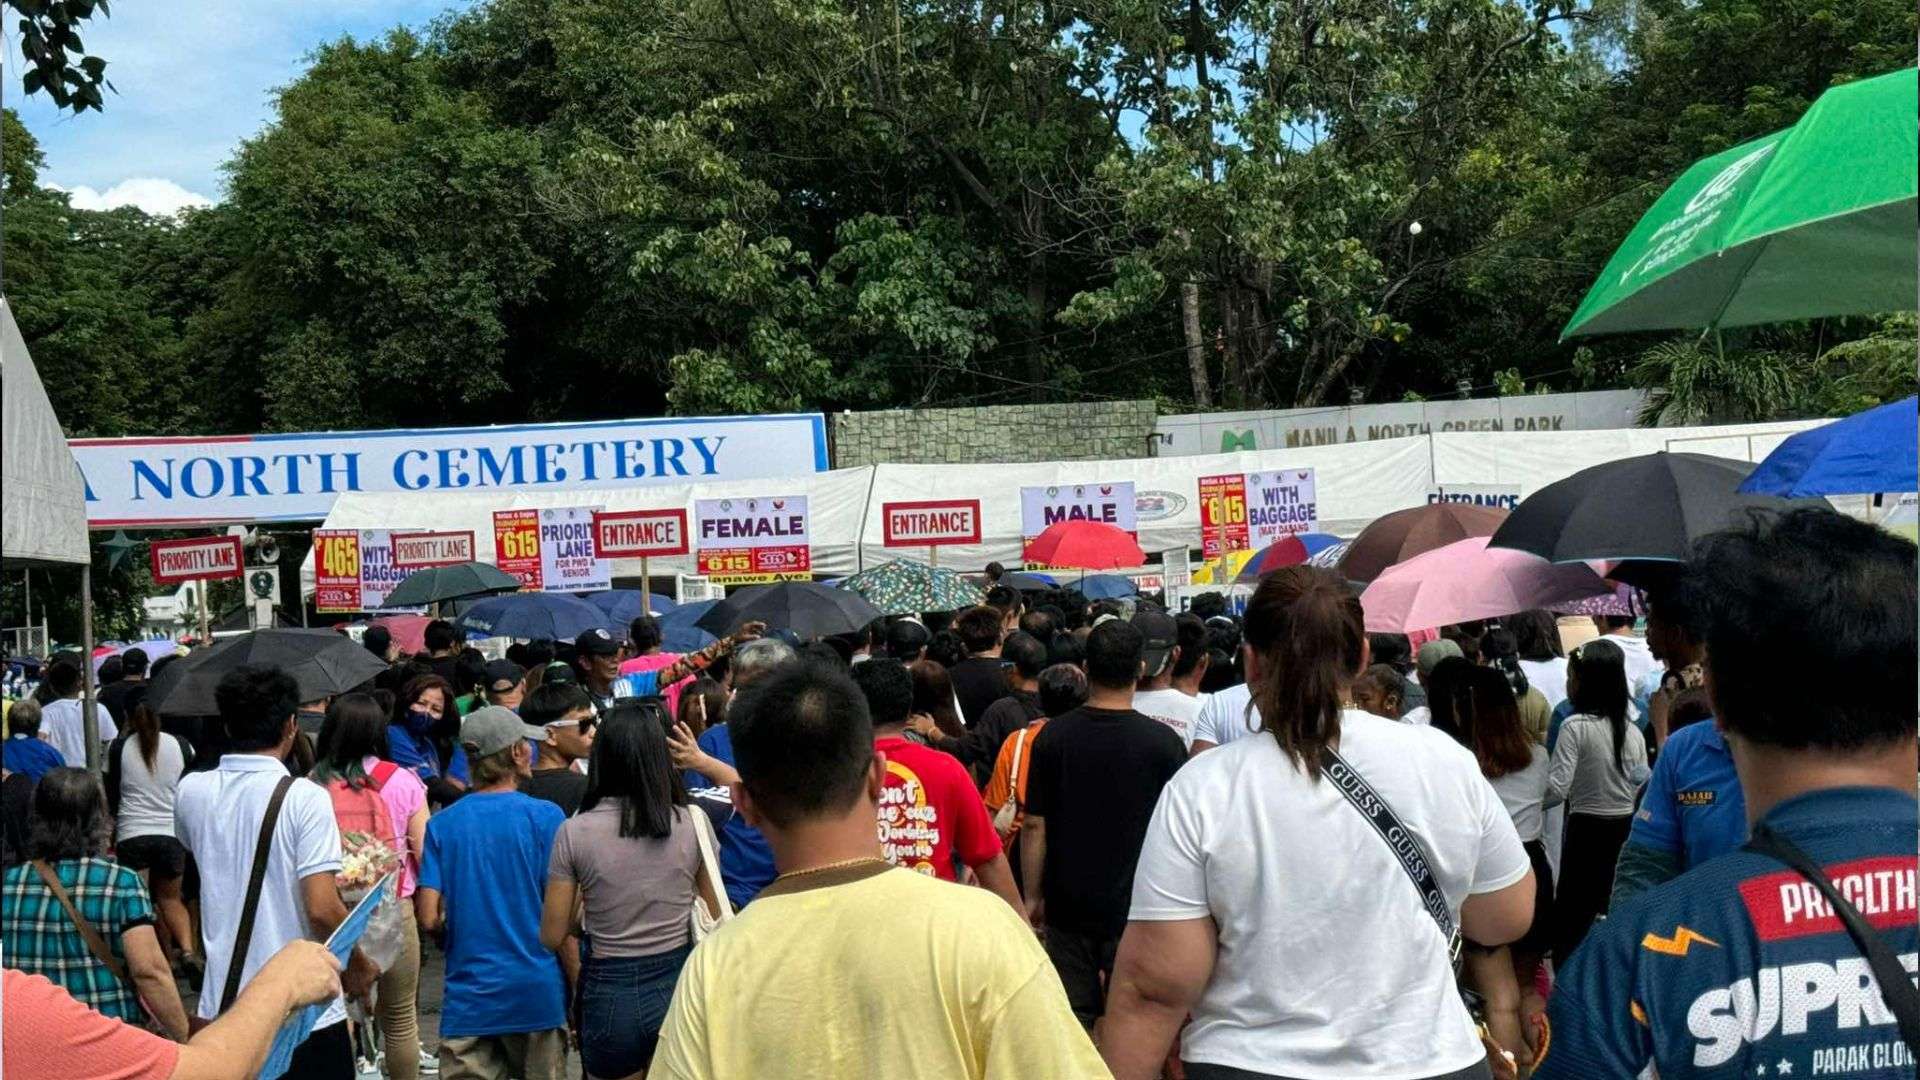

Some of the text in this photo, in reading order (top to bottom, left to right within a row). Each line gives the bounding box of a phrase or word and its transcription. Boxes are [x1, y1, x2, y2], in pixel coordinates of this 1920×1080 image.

[1286, 425, 1357, 448] MANILA
[1368, 421, 1431, 441] NORTH
[1514, 415, 1563, 432] PARK
[129, 452, 364, 500] NORTH
[392, 436, 728, 491] CEMETERY
[1262, 485, 1300, 506] WITH
[892, 512, 970, 535] ENTRANCE
[1044, 503, 1117, 526] MALE
[1249, 502, 1317, 525] BAGGAGE
[541, 523, 594, 543] PRIORIT
[602, 521, 675, 547] ENTRANCE
[702, 515, 804, 539] FEMALE
[160, 547, 235, 571] PRIORITY LANE
[397, 539, 468, 560] PRIORITY LANE
[556, 540, 593, 558] LANE
[362, 565, 418, 581] BAGGA
[555, 560, 571, 568] FOR
[562, 569, 591, 577] SENIOR
[708, 575, 768, 584] anawe
[878, 779, 920, 805] on't
[1329, 762, 1384, 819] GUESS
[1388, 826, 1429, 882] GUESS
[1812, 1043, 1870, 1075] PARAK
